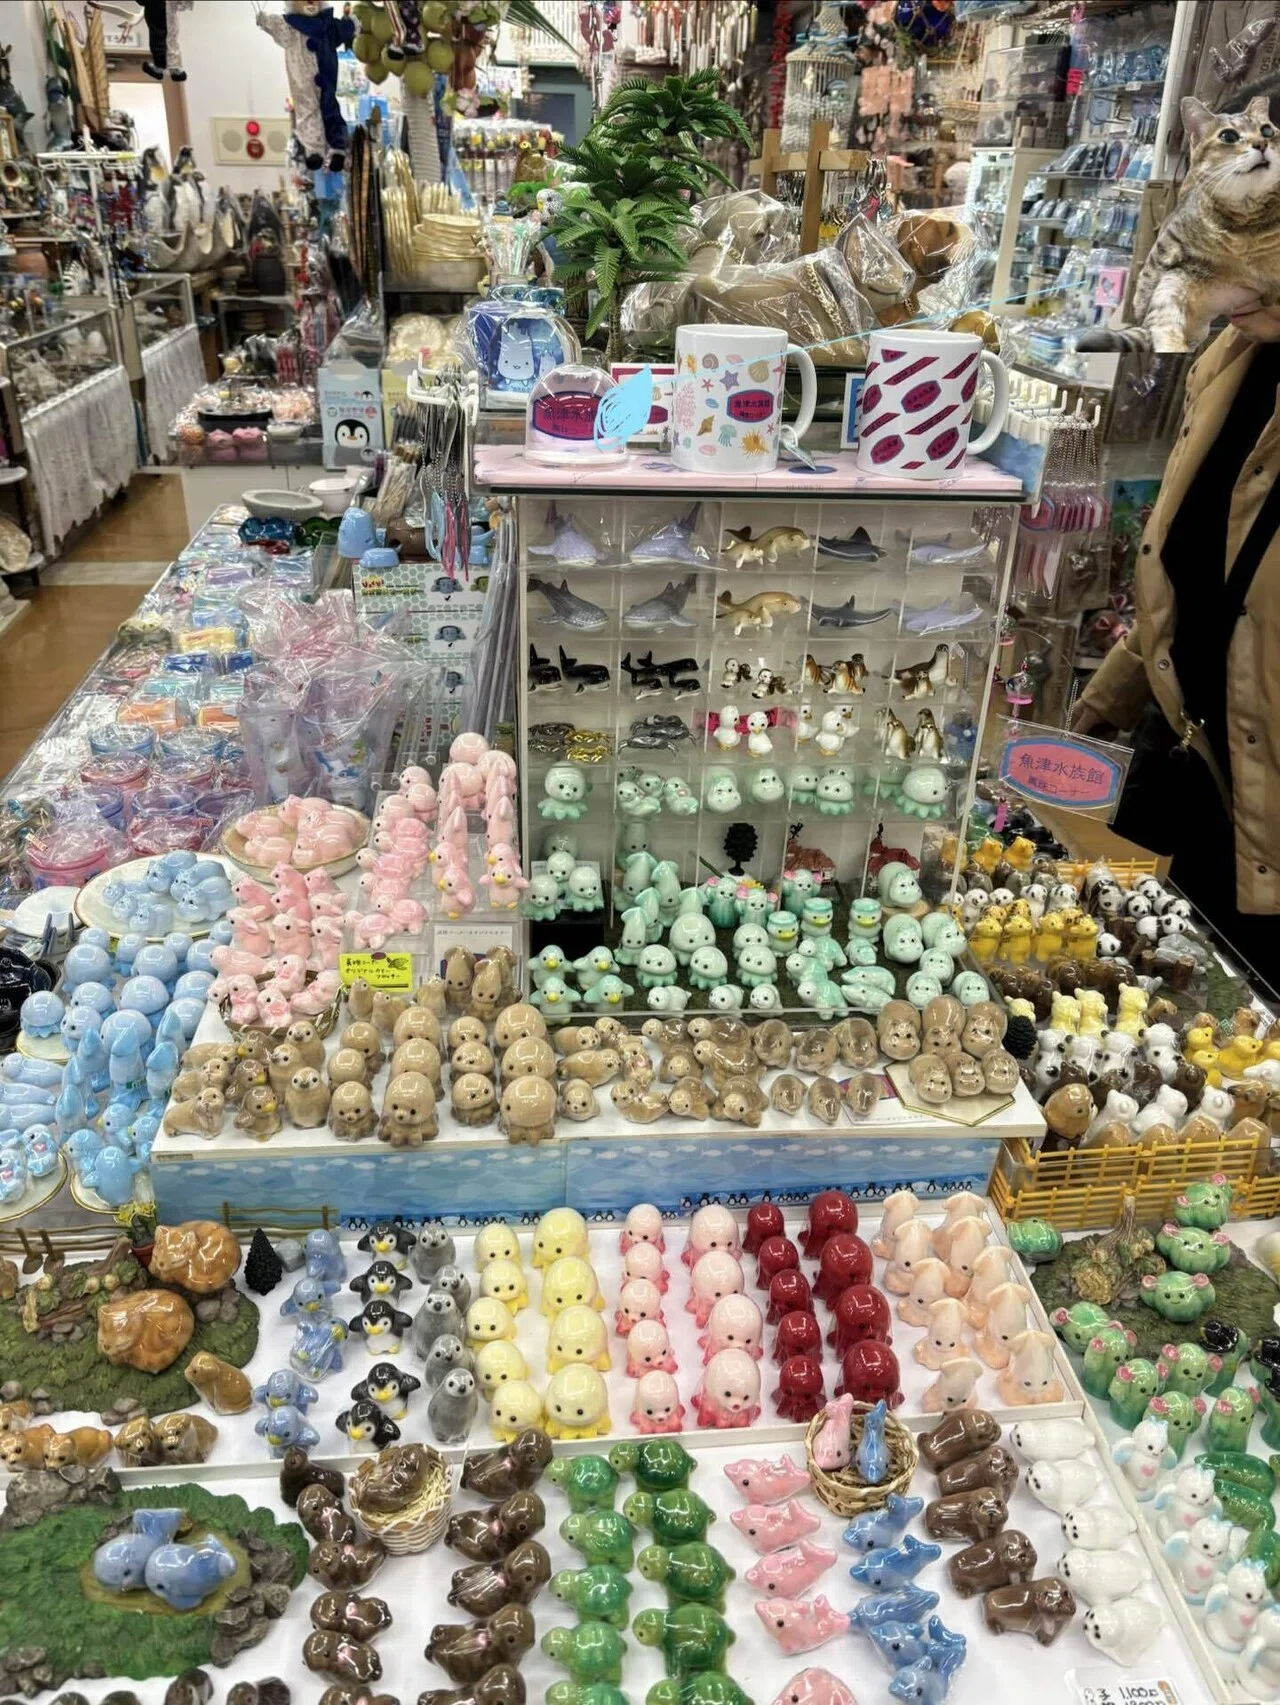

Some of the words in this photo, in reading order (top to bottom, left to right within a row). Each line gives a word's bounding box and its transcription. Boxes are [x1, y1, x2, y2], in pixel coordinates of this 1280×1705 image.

[1018, 752, 1105, 785] 魚津水族館
